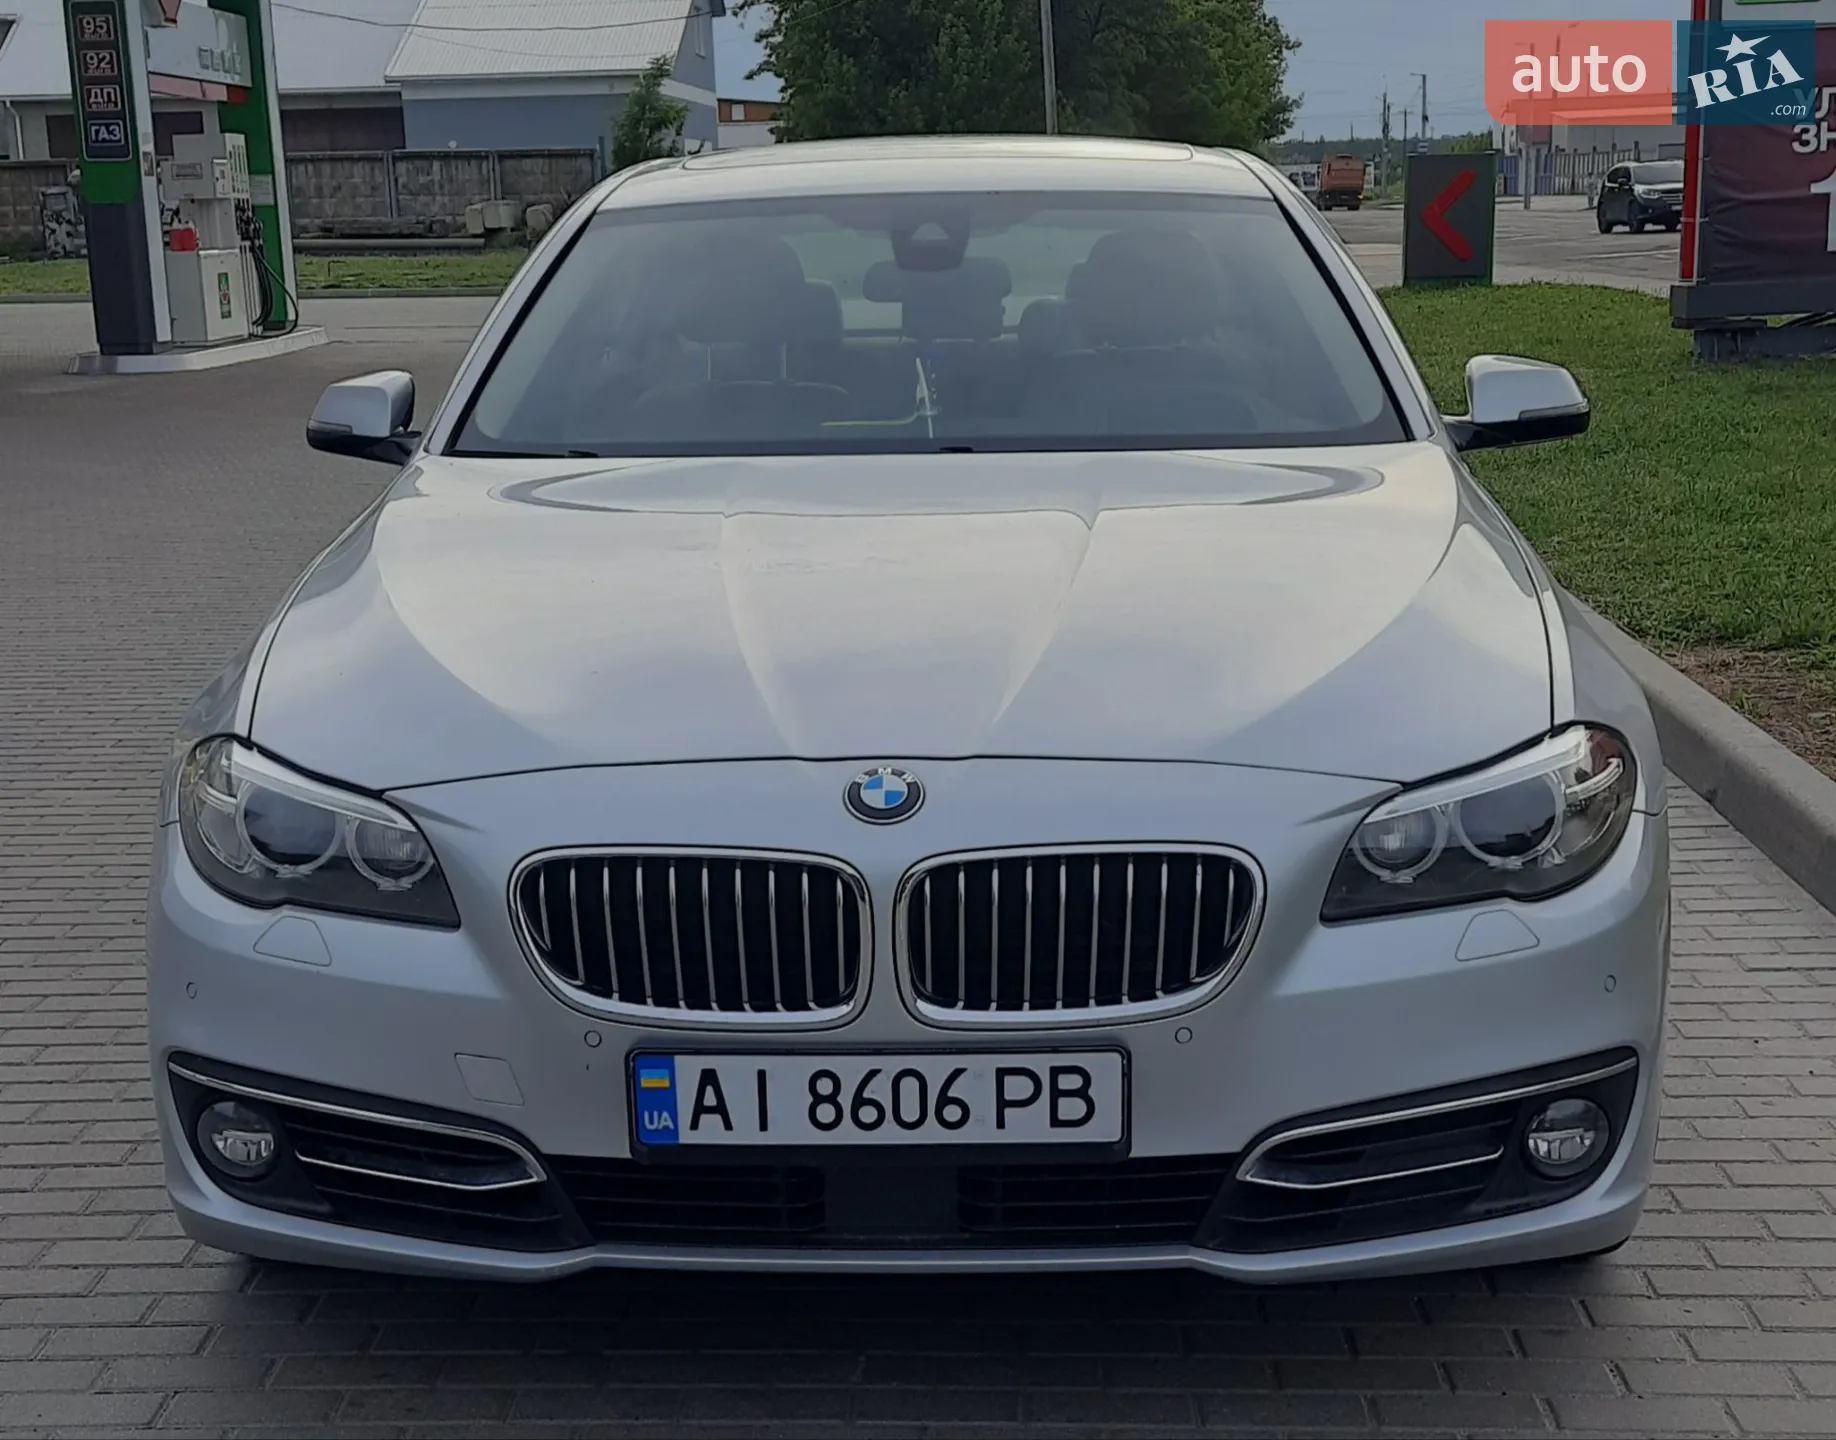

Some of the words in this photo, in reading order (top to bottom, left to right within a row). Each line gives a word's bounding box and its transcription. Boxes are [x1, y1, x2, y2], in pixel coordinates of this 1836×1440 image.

[82, 16, 108, 33] 95
[86, 52, 111, 69] 92
[90, 88, 116, 105] ДП
[91, 125, 121, 141] ГАЗ
[855, 767, 917, 784] BMW
[689, 1068, 769, 1132] AI
[807, 1067, 971, 1132] 8606
[994, 1065, 1097, 1130] PB
[644, 1109, 675, 1131] UA
